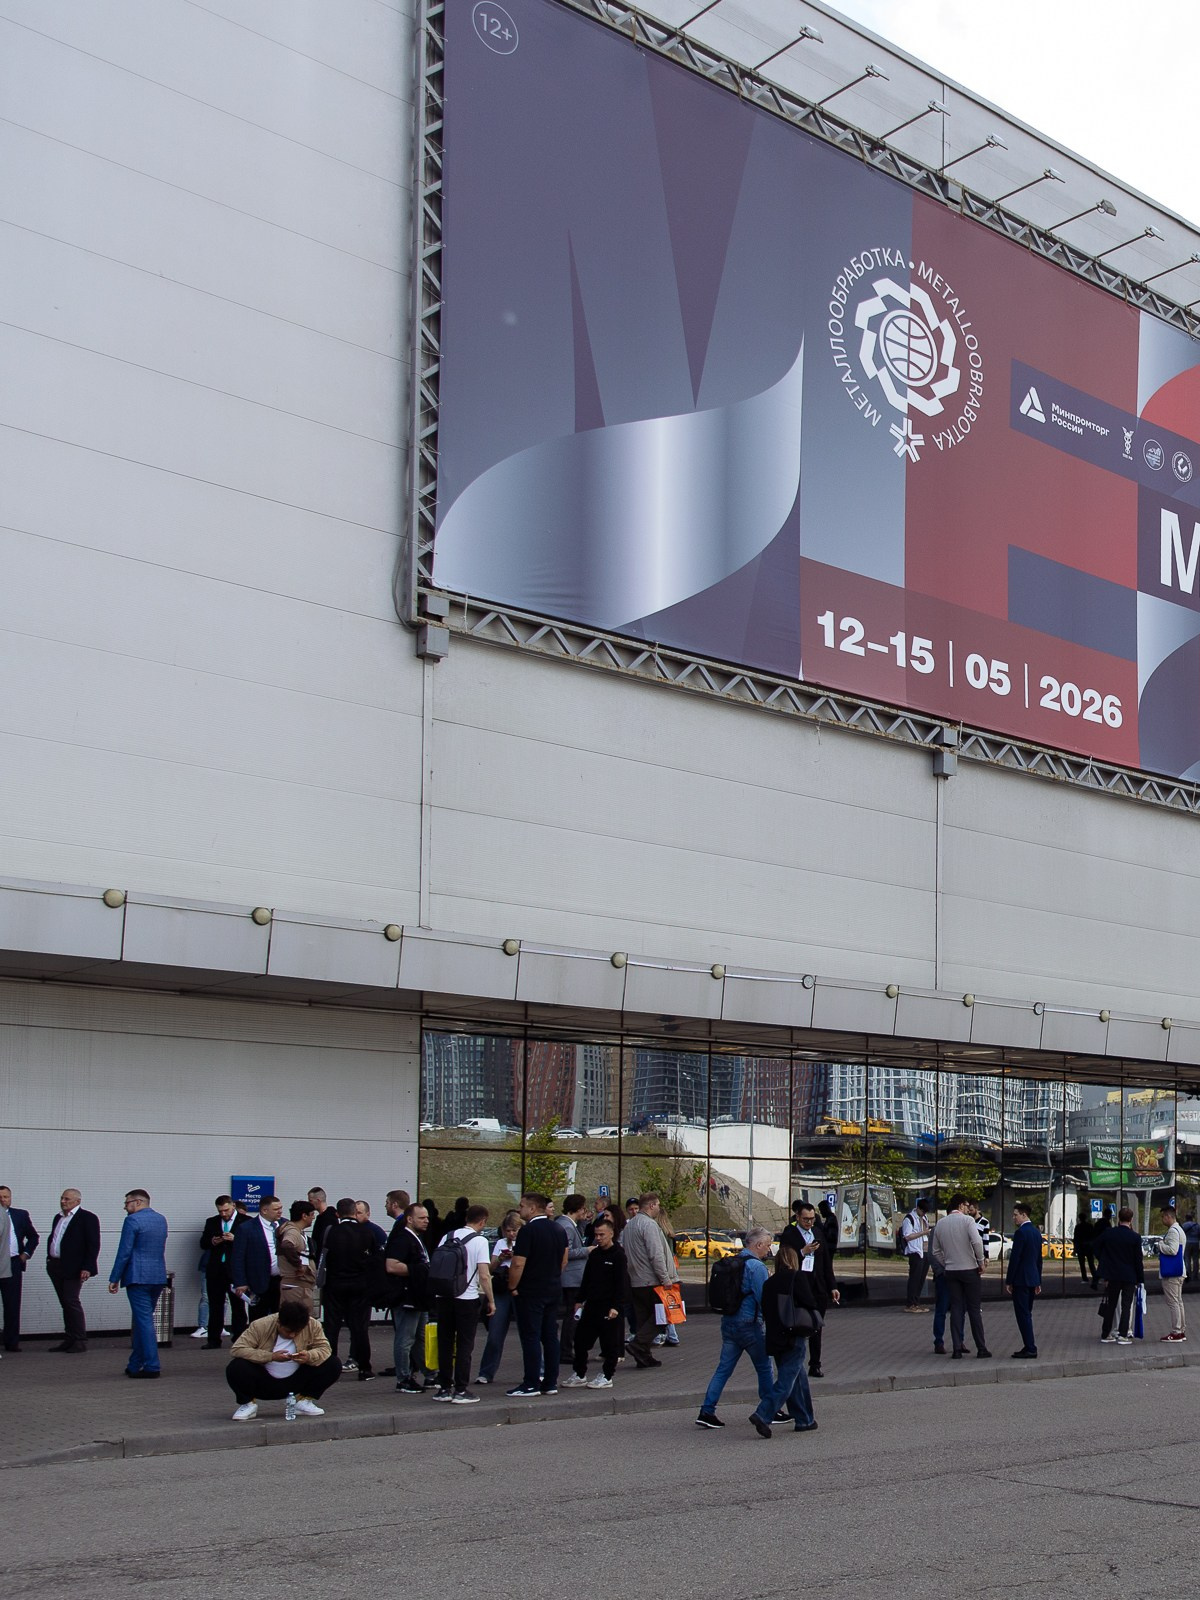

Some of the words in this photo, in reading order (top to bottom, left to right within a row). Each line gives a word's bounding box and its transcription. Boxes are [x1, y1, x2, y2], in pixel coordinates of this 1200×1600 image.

[479, 12, 513, 41] 12+
[828, 247, 906, 427] МЕТАЛЛООБРАБОТКА
[917, 260, 984, 451] METALLOOBRABOTKA
[1051, 402, 1110, 437] Минпромторг
[1051, 413, 1083, 436] России
[964, 652, 1012, 696] 05
[1039, 675, 1123, 728] 2026
